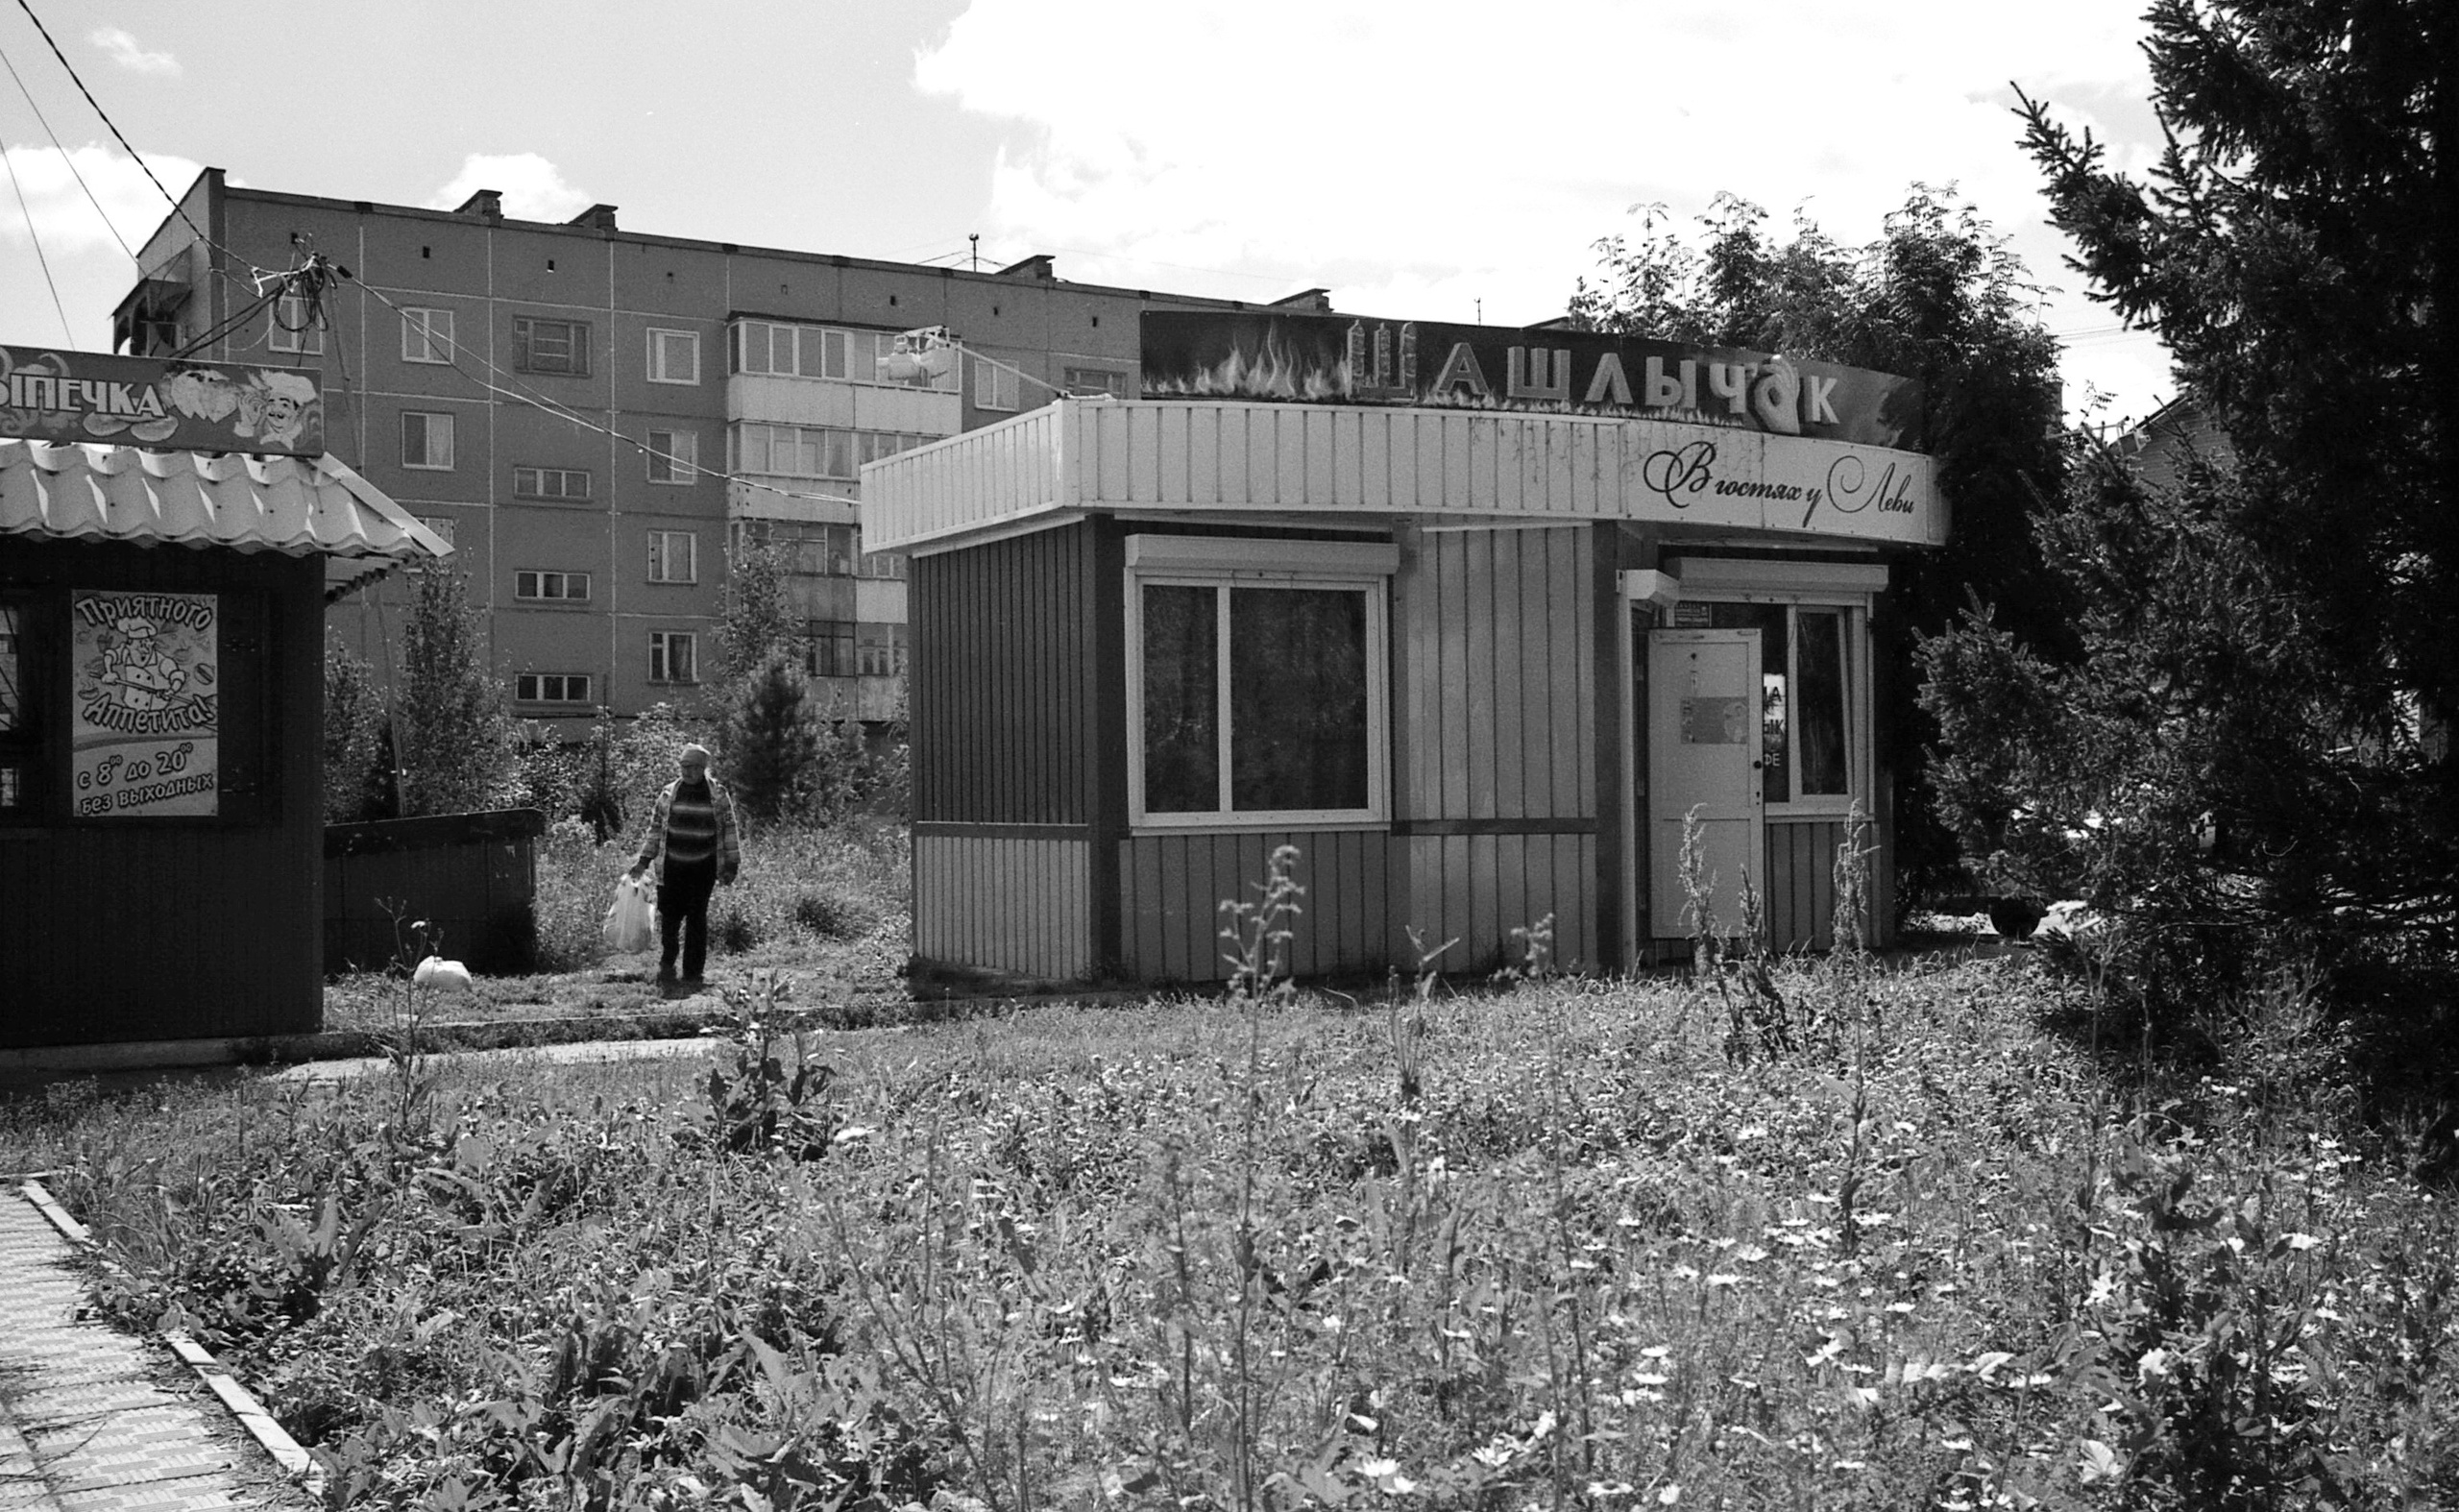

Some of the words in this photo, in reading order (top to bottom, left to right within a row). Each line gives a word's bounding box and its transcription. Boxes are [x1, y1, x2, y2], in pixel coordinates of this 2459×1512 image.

[1643, 440, 1717, 509] В
[1715, 478, 1802, 501] гостях
[1804, 488, 1822, 528] у
[1827, 455, 1915, 514] Леви
[75, 596, 212, 631] Приятного
[83, 693, 215, 733] Аппетита!
[125, 761, 152, 782] до
